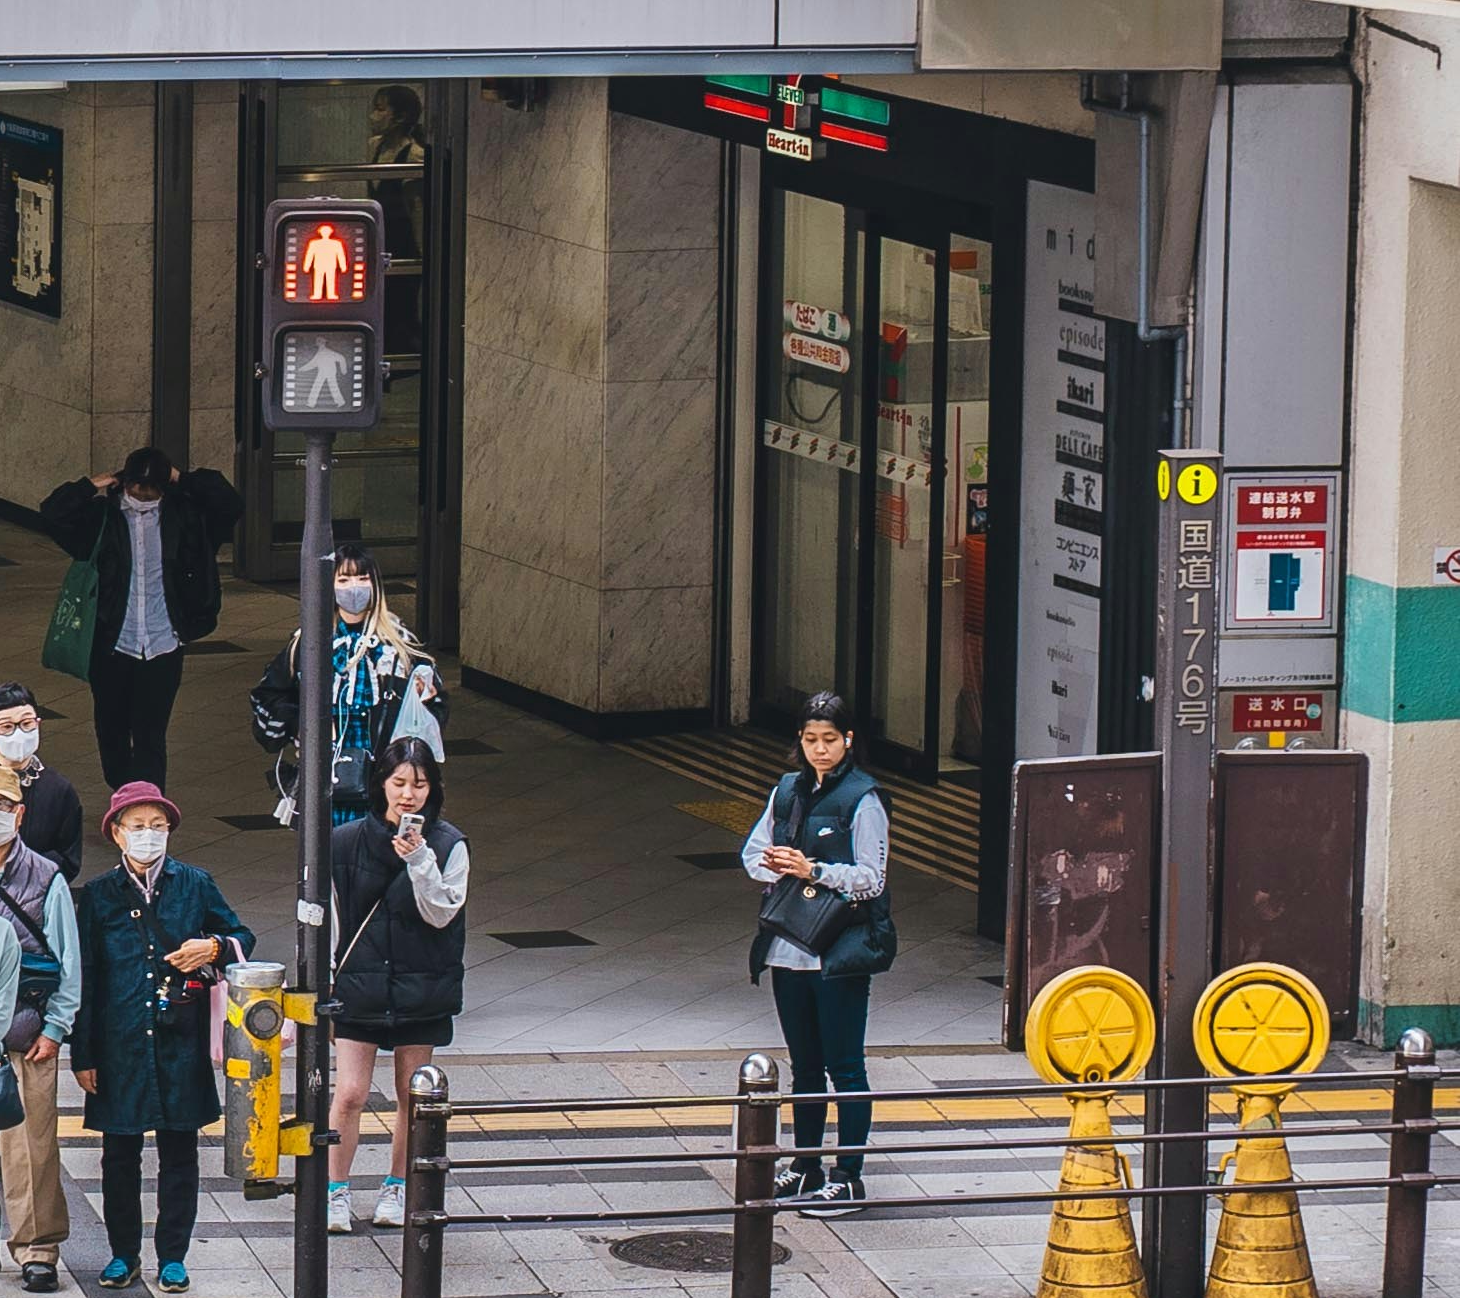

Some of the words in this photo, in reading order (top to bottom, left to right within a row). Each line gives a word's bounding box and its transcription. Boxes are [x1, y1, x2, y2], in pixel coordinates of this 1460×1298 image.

[767, 132, 810, 158] Heart-in
[1059, 322, 1104, 352] episode
[1055, 434, 1078, 453] DELI
[1056, 537, 1099, 560] コンビニエンス
[1068, 557, 1087, 573] ストア
[1175, 520, 1213, 735] 国道176号
[1248, 697, 1307, 712] 送水口
